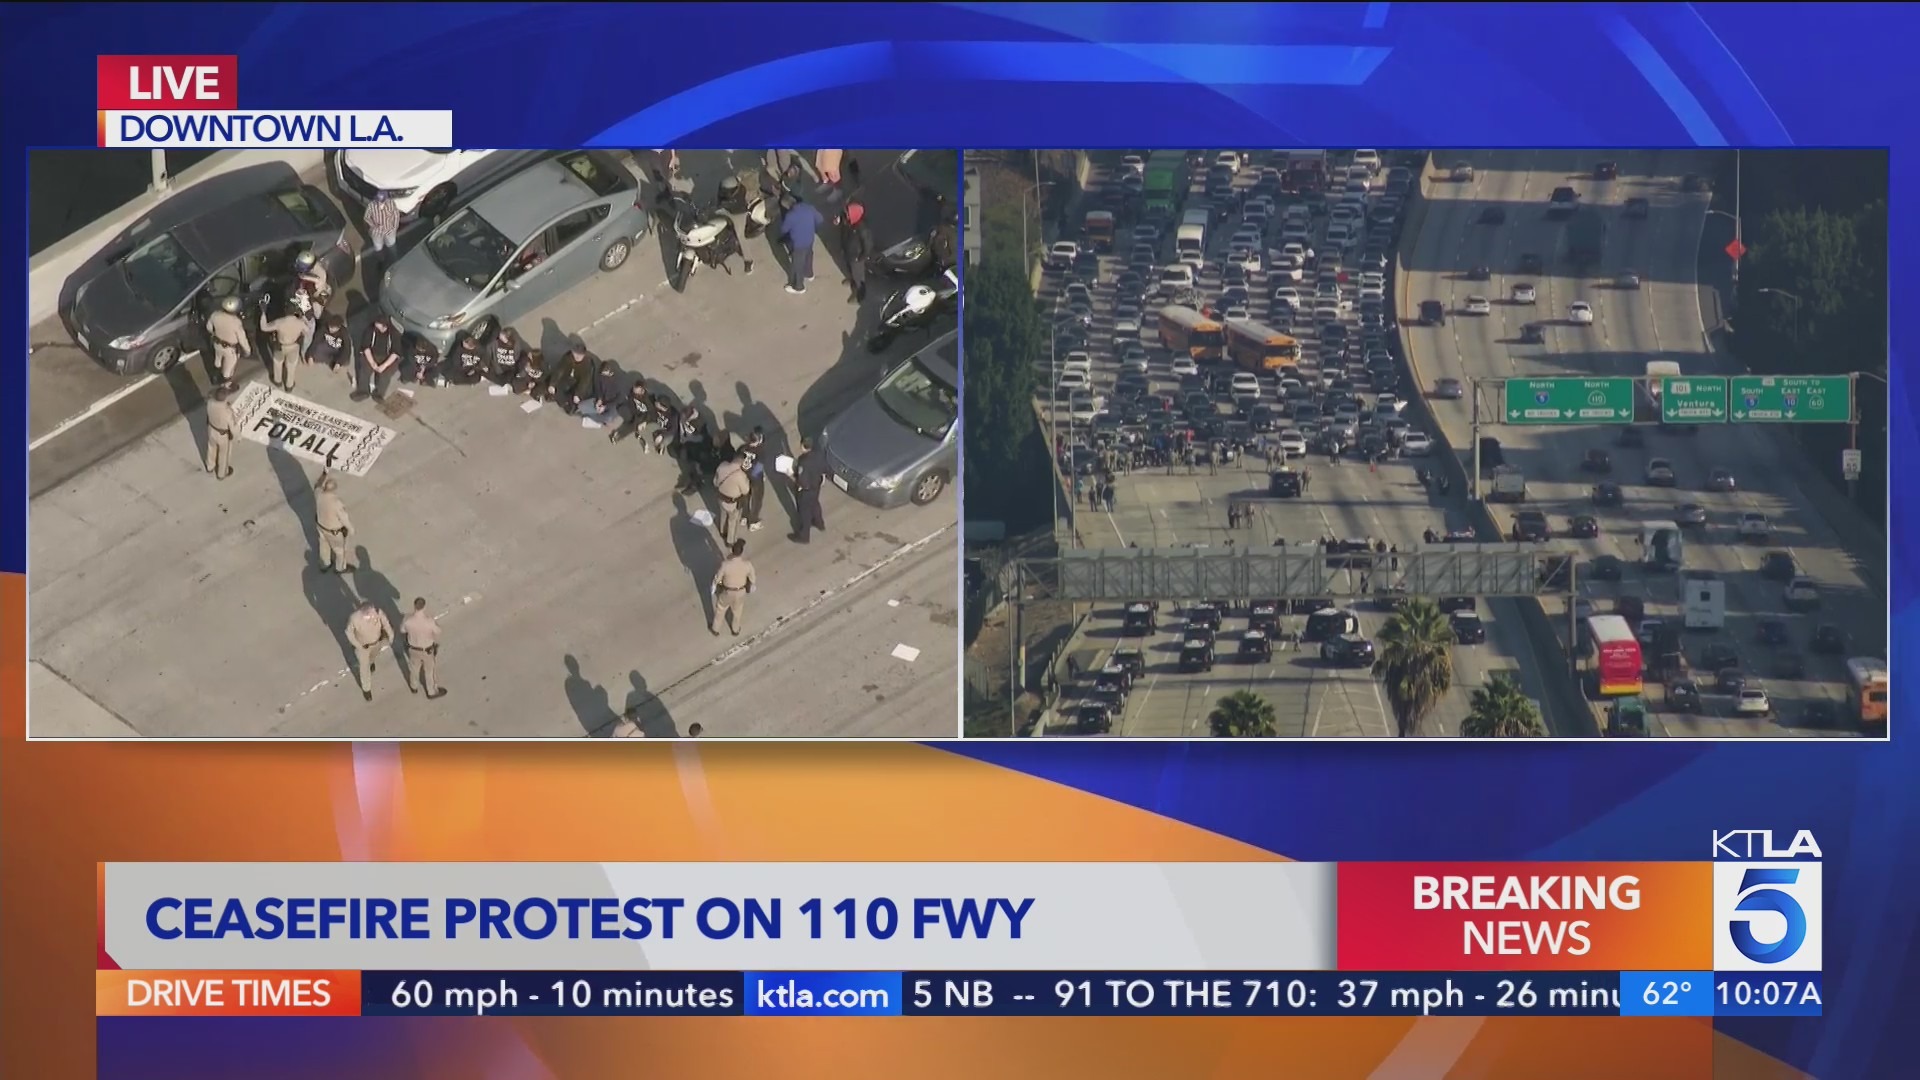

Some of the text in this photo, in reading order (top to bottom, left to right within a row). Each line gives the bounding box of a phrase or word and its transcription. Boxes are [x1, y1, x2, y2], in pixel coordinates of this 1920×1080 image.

[1529, 381, 1555, 389] NORTH
[1696, 384, 1722, 392] NORTH
[1741, 387, 1764, 395] SOUTH
[1677, 399, 1715, 407] Ventura
[253, 416, 303, 445] FOR
[299, 433, 341, 460] ALL
